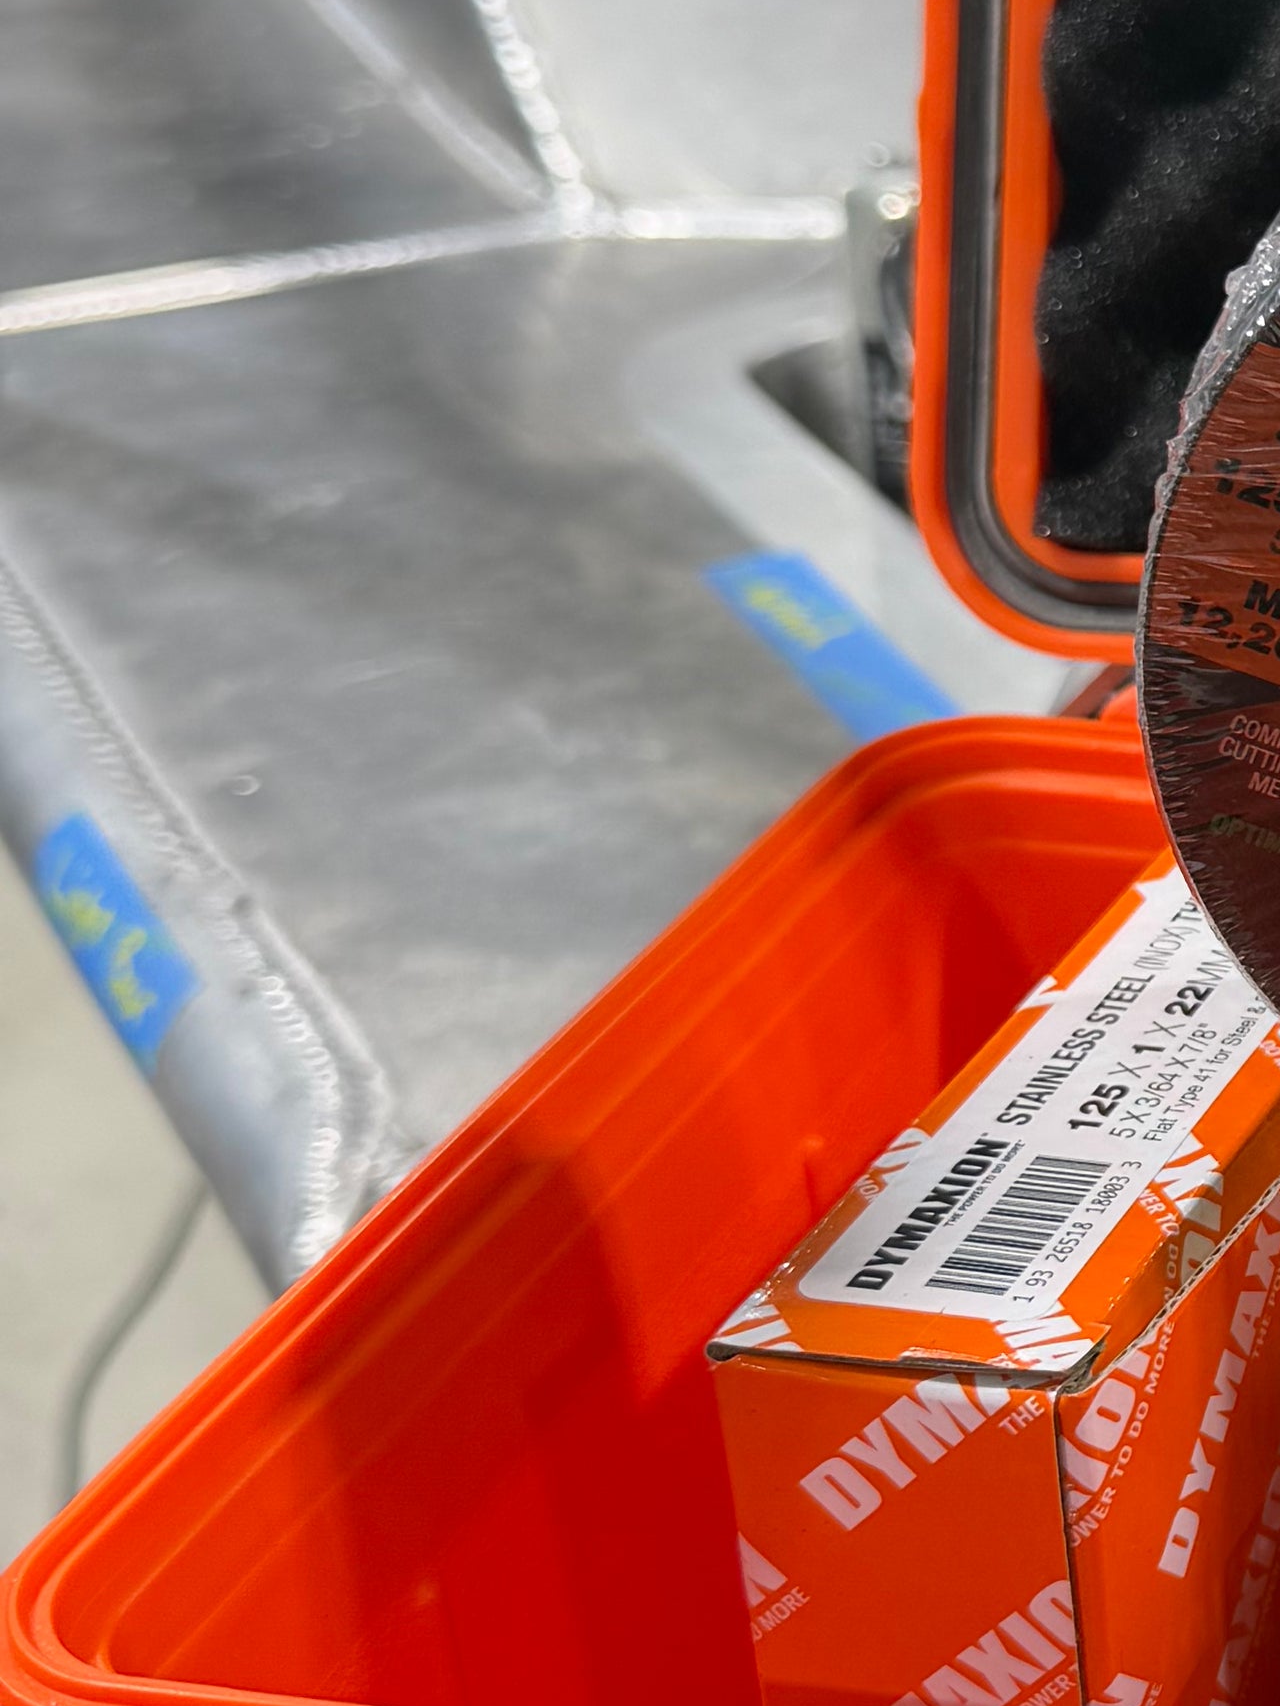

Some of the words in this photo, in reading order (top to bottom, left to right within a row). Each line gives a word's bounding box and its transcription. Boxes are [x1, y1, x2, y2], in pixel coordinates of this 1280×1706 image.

[997, 1026, 1105, 1126] STAINLESS
[1090, 974, 1155, 1026] STEEL
[1133, 928, 1190, 971] (INOX)
[1133, 1044, 1168, 1055] 1
[1143, 1021, 1185, 1039] X
[1108, 1062, 1147, 1079] X
[1143, 1111, 1177, 1142] Flat
[1164, 1080, 1205, 1117] Type
[1189, 1066, 1215, 1086] 41
[1205, 1041, 1229, 1070] for
[1221, 1015, 1259, 1046] Steel
[1067, 1083, 1131, 1131] 125
[1109, 1125, 1136, 1139] 5
[1135, 1067, 1180, 1107] 3/64
[1110, 1445, 1132, 1479] TO
[1127, 1401, 1149, 1438] DO
[1144, 1320, 1175, 1394] MORE
